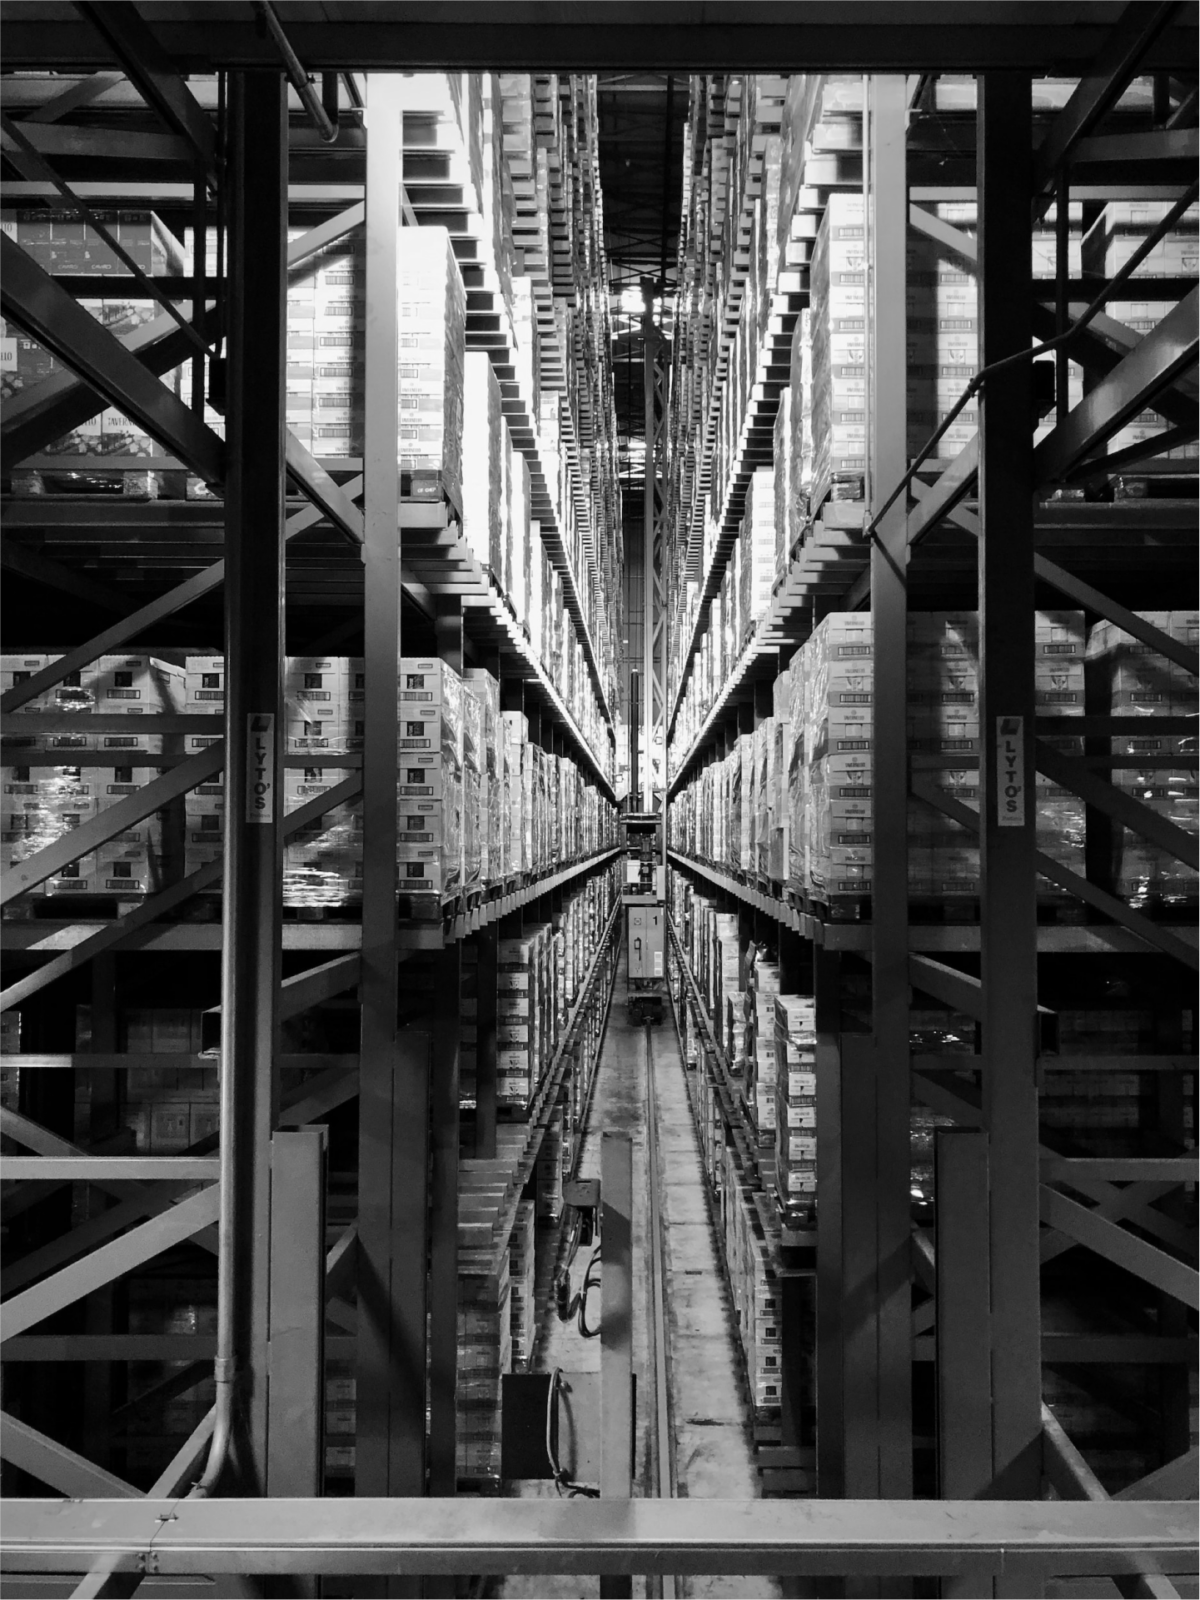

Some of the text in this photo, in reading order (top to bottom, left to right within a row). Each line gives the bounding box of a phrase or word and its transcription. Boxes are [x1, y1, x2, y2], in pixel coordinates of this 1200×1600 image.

[253, 738, 270, 810] LYTO'S
[1004, 740, 1022, 813] LYTO'S
[652, 916, 658, 926] 1
